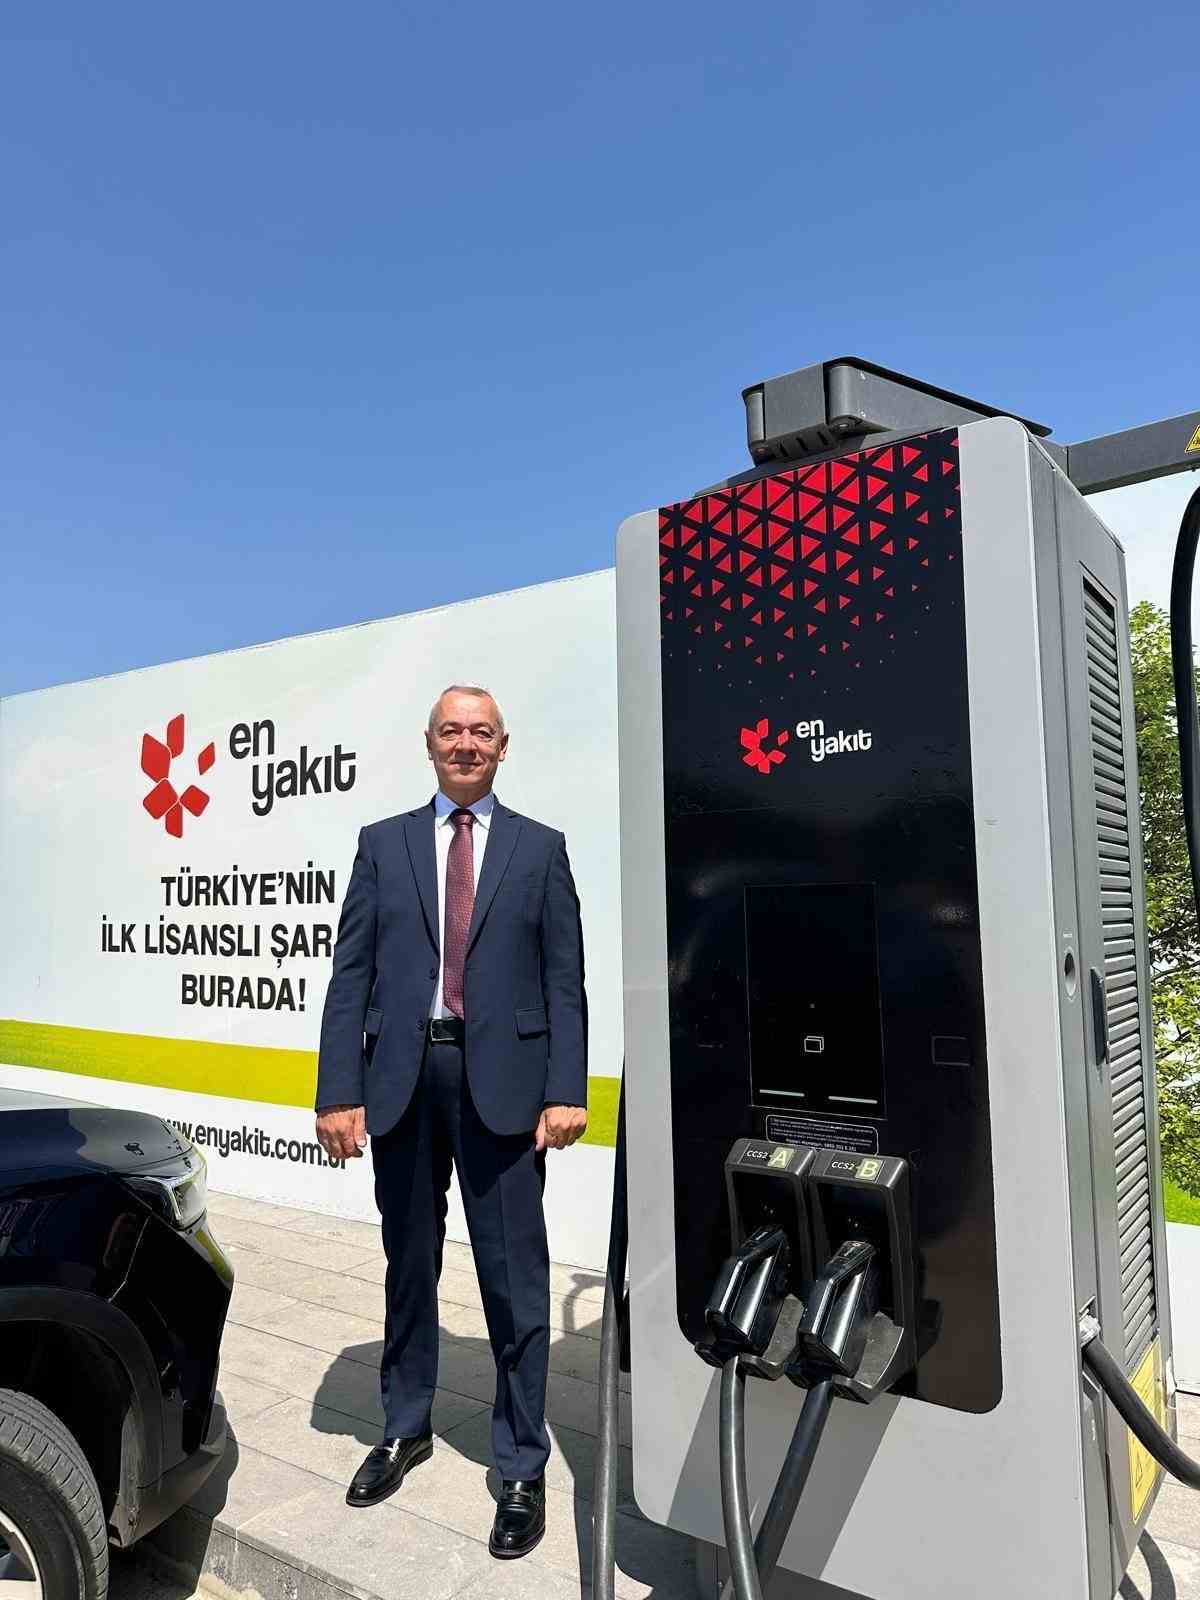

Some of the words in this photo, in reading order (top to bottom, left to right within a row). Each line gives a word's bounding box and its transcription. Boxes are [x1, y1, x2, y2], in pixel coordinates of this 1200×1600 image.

[229, 719, 275, 760] en
[796, 719, 824, 738] en
[251, 744, 357, 817] yakıt
[101, 914, 137, 953] İLK
[144, 914, 260, 957] LİSANSLI
[270, 923, 336, 969] ŞAR
[181, 973, 306, 1012] BURADA!
[774, 1150, 788, 1166] A
[861, 1161, 879, 1177] B
